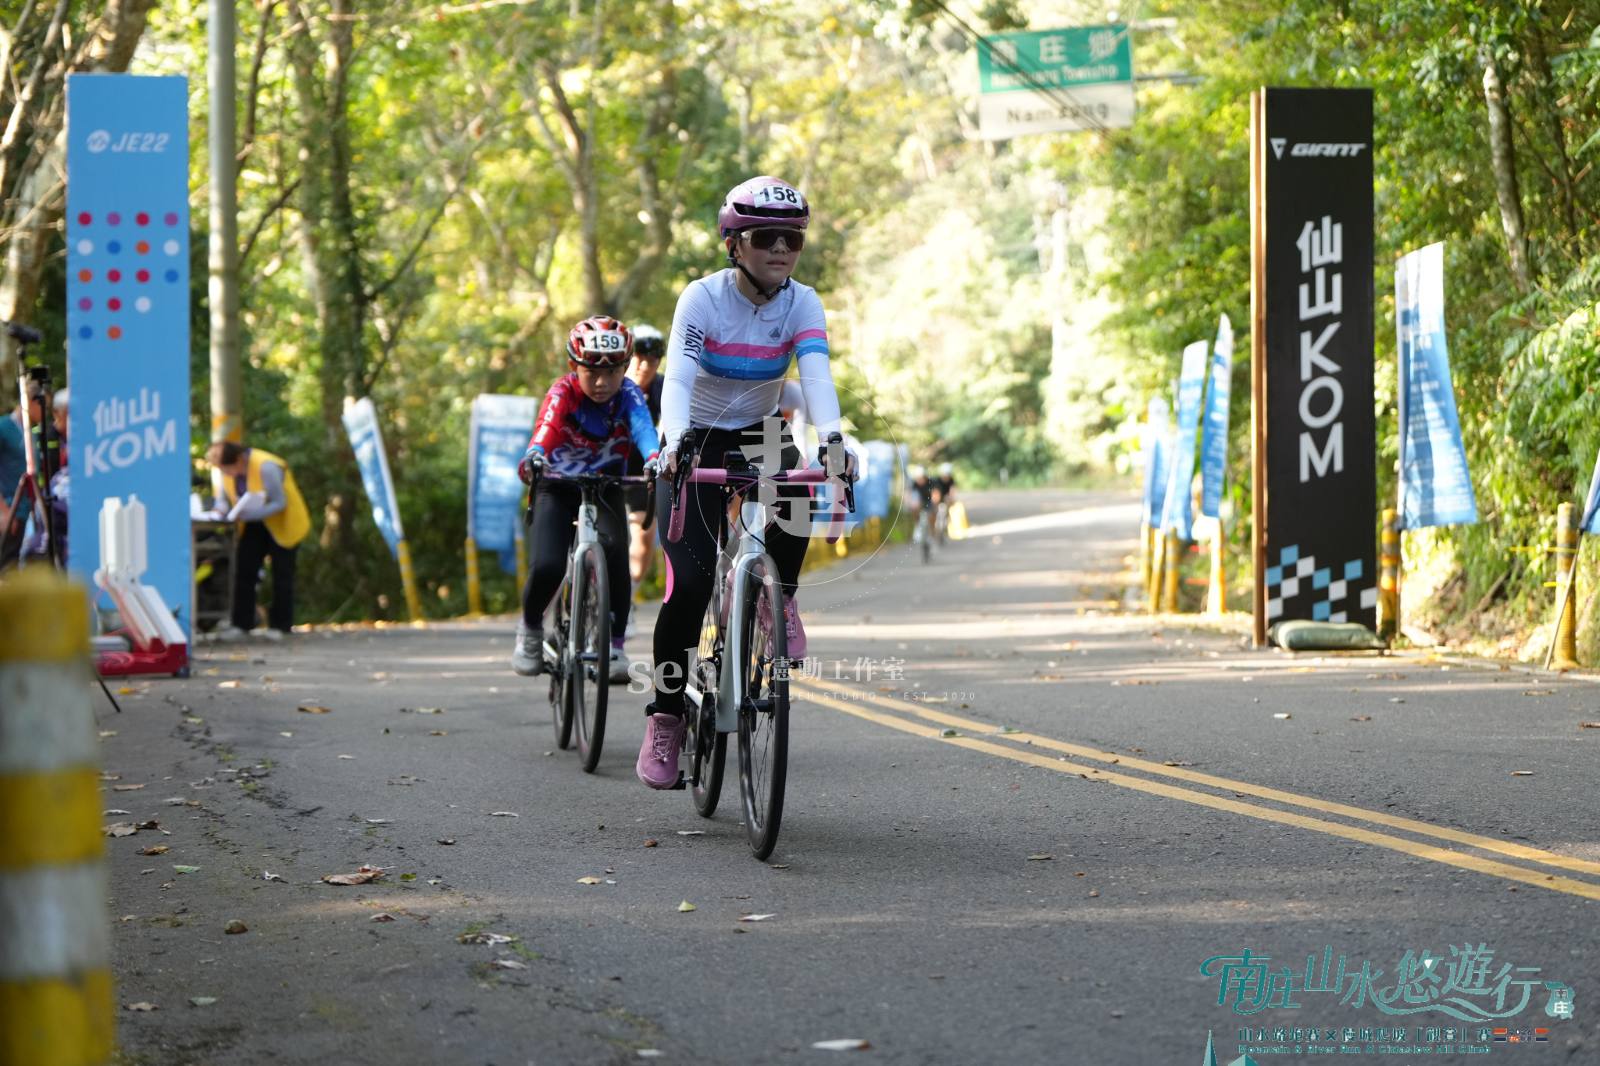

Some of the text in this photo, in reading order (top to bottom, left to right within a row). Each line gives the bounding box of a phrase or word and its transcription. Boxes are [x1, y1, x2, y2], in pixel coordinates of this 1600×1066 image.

[112, 133, 170, 152] JE22
[1290, 142, 1366, 157] GIANT
[760, 186, 797, 204] 158
[590, 334, 620, 350] 159
[93, 387, 160, 436] 仙山
[84, 419, 176, 478] KOM
